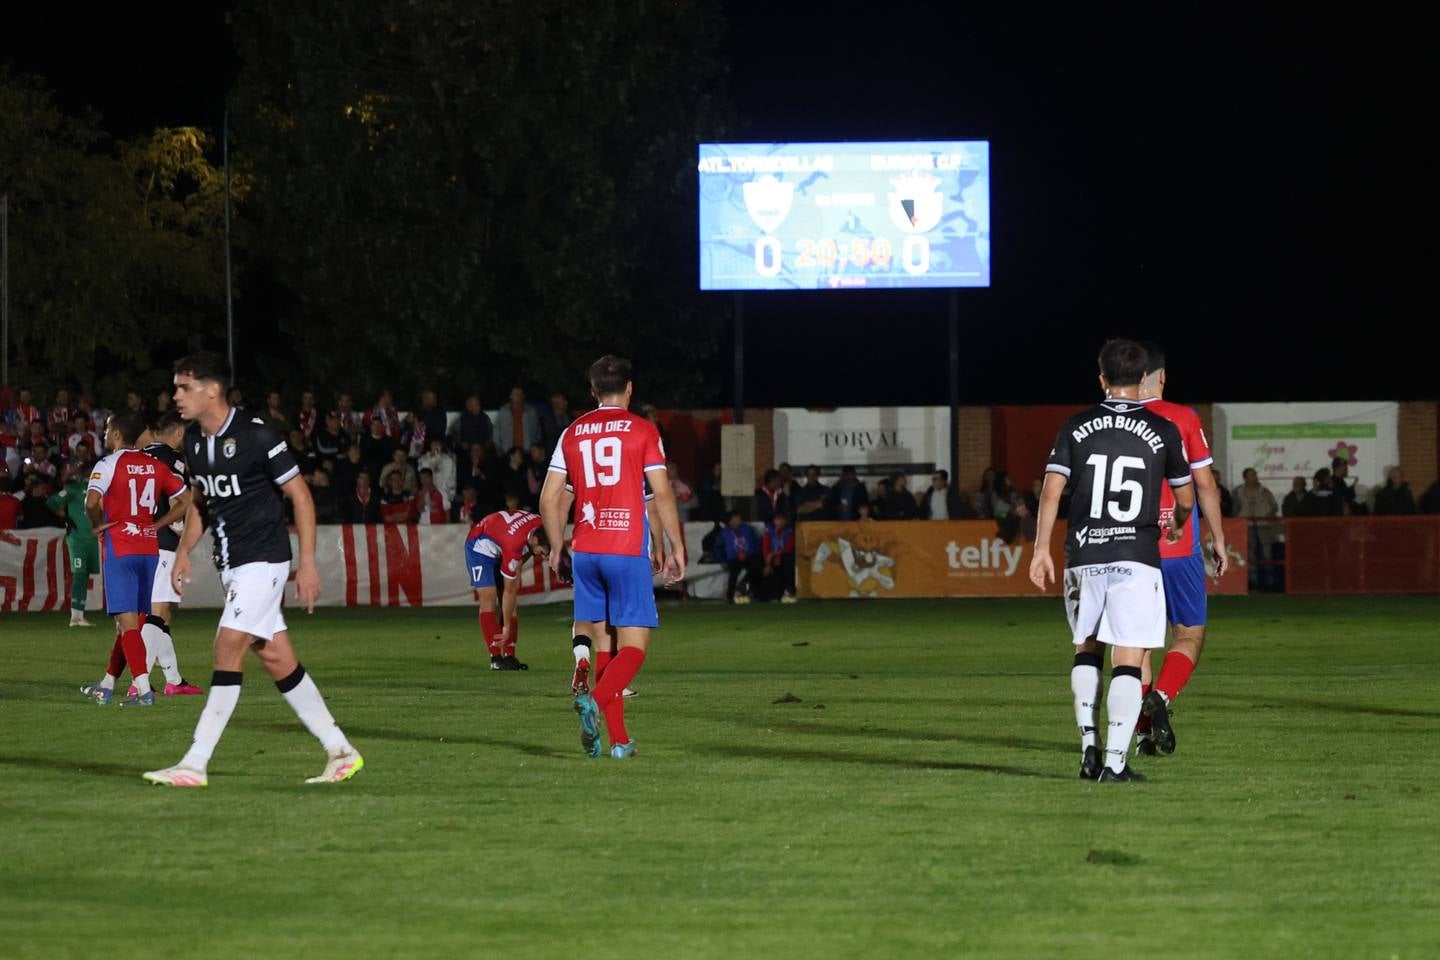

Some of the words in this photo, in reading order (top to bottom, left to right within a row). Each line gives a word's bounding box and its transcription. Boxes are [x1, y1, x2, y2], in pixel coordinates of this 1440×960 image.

[755, 237, 782, 276] 0
[903, 235, 930, 276] 0
[575, 423, 602, 436] DANI
[605, 420, 632, 432] DIEZ
[819, 431, 904, 451] TORVAL
[1072, 415, 1113, 443] AITOR
[1115, 415, 1164, 454] BUÑUEL
[579, 437, 622, 488] 19
[129, 478, 156, 516] 14
[1086, 453, 1146, 523] 15
[1088, 526, 1136, 538] cajarural
[472, 566, 483, 582] 17
[945, 538, 1023, 576] telfy
